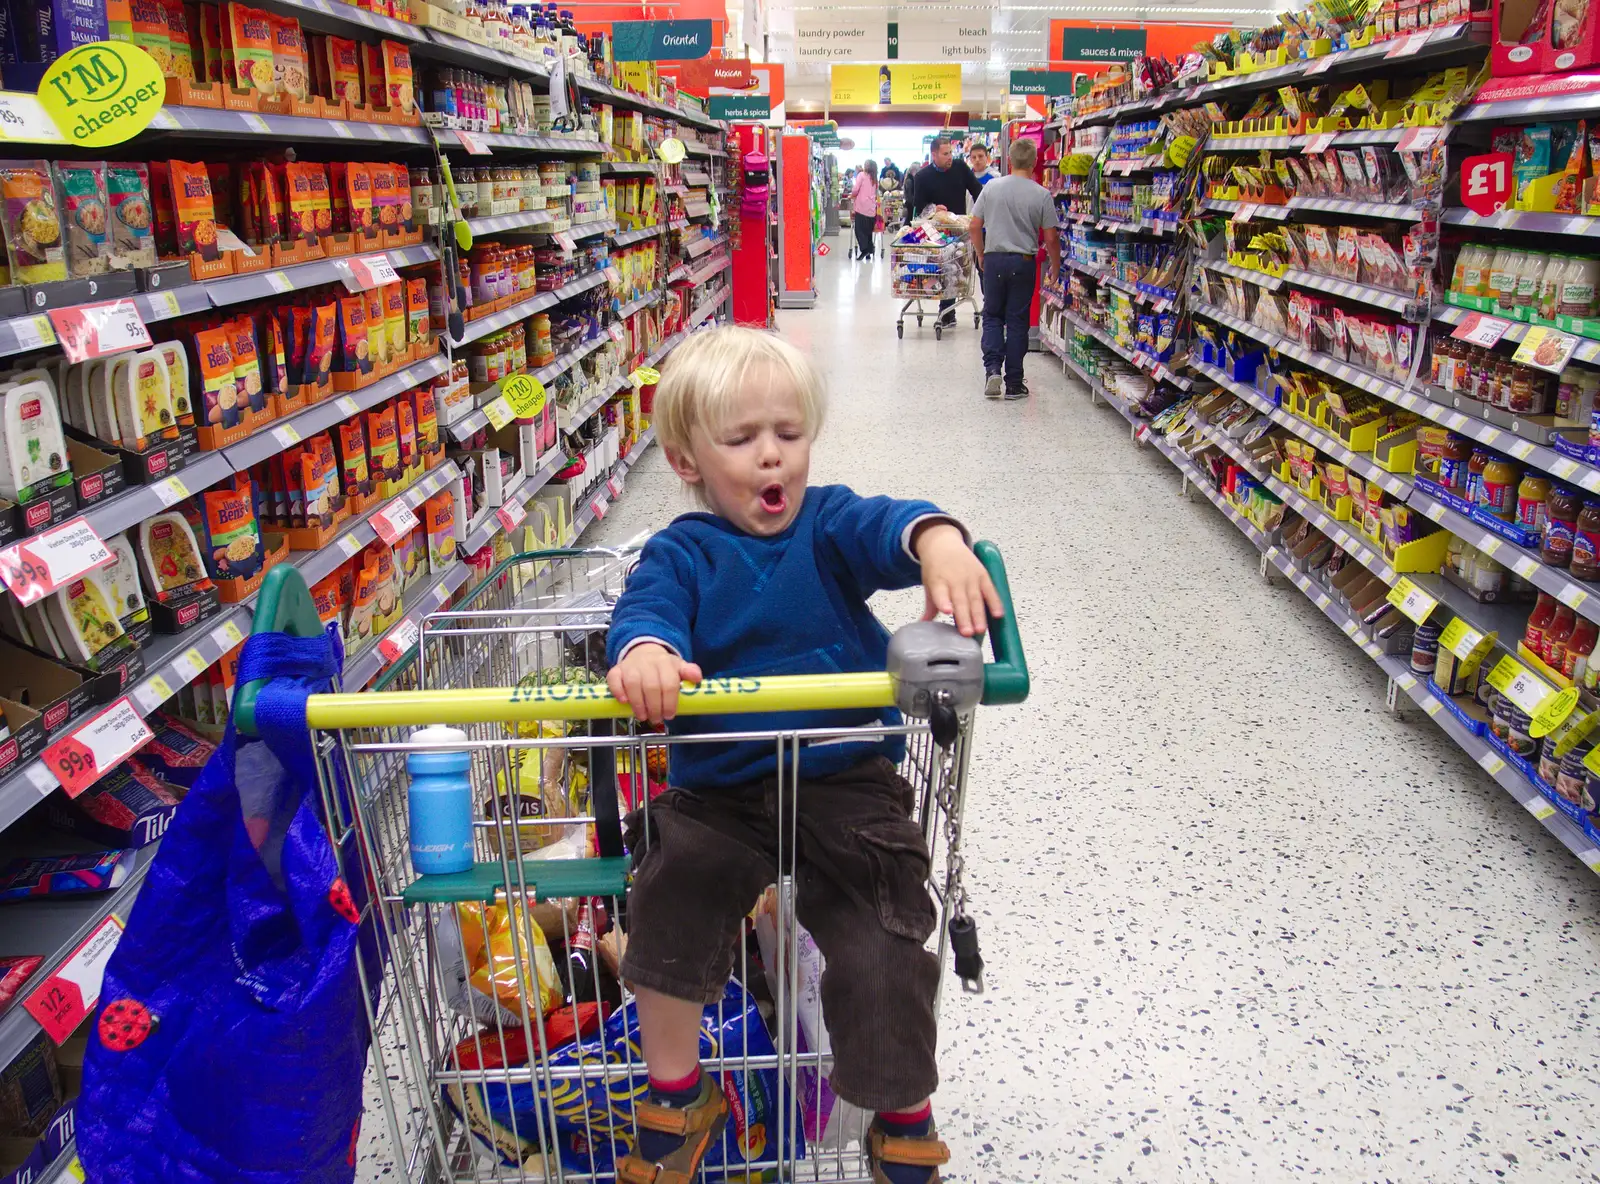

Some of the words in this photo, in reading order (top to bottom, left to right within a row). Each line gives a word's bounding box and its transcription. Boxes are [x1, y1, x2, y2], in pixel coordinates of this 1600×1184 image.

[75, 16, 95, 29] PURE
[798, 29, 831, 39] laundry
[832, 29, 865, 39] powder
[959, 27, 987, 37] bleach
[663, 33, 698, 46] Oriental
[888, 37, 898, 45] 10
[799, 47, 832, 57] laundry
[942, 46, 962, 56] light
[963, 46, 987, 54] bulbs
[1081, 48, 1108, 56] sauces
[1118, 49, 1143, 57] mixes
[714, 69, 743, 77] Mexican
[50, 54, 119, 107] I'M
[912, 82, 933, 90] Love
[934, 82, 942, 90] it
[1013, 84, 1023, 92] hot
[1477, 91, 1502, 101] DISCOVER
[1500, 86, 1537, 98] DELICIOUSLY
[1538, 80, 1567, 93] WARMING
[189, 91, 214, 101] SPECIAL
[912, 92, 948, 101] cheaper
[73, 81, 159, 139] cheaper
[231, 99, 253, 109] SPECIAL
[725, 108, 742, 116] herbs
[749, 109, 768, 118] spices
[1468, 161, 1505, 196] £1
[201, 263, 226, 272] SPECIAL
[242, 260, 265, 268] SPECIAL
[1565, 288, 1593, 300] Tonight
[125, 322, 146, 339] 95p
[506, 379, 529, 401] I'M
[516, 392, 544, 416] cheaper
[223, 431, 247, 445] SPECIAL
[83, 478, 101, 493] Veetee
[105, 476, 122, 487] AMAZING
[52, 496, 67, 506] SIMPLY
[222, 499, 243, 511] Uncle
[29, 503, 49, 518] Veetee
[53, 502, 72, 515] AMAZING
[54, 514, 62, 523] RICE
[400, 511, 413, 524] £1.69
[154, 525, 171, 537] Veetee
[9, 560, 48, 587] 99p
[181, 607, 197, 620] Veetee
[1514, 681, 1525, 694] 89p
[46, 706, 67, 721] Veetee
[93, 724, 109, 735] Veetee
[108, 717, 118, 727] Dine
[121, 707, 131, 717] Rice
[18, 729, 34, 741] SIMPLY
[131, 727, 146, 742] £1.49
[21, 733, 43, 750] AMAZING
[22, 751, 32, 759] RICE
[59, 751, 93, 779] 99p
[40, 987, 65, 1012] 1/2
[55, 1002, 72, 1024] price
